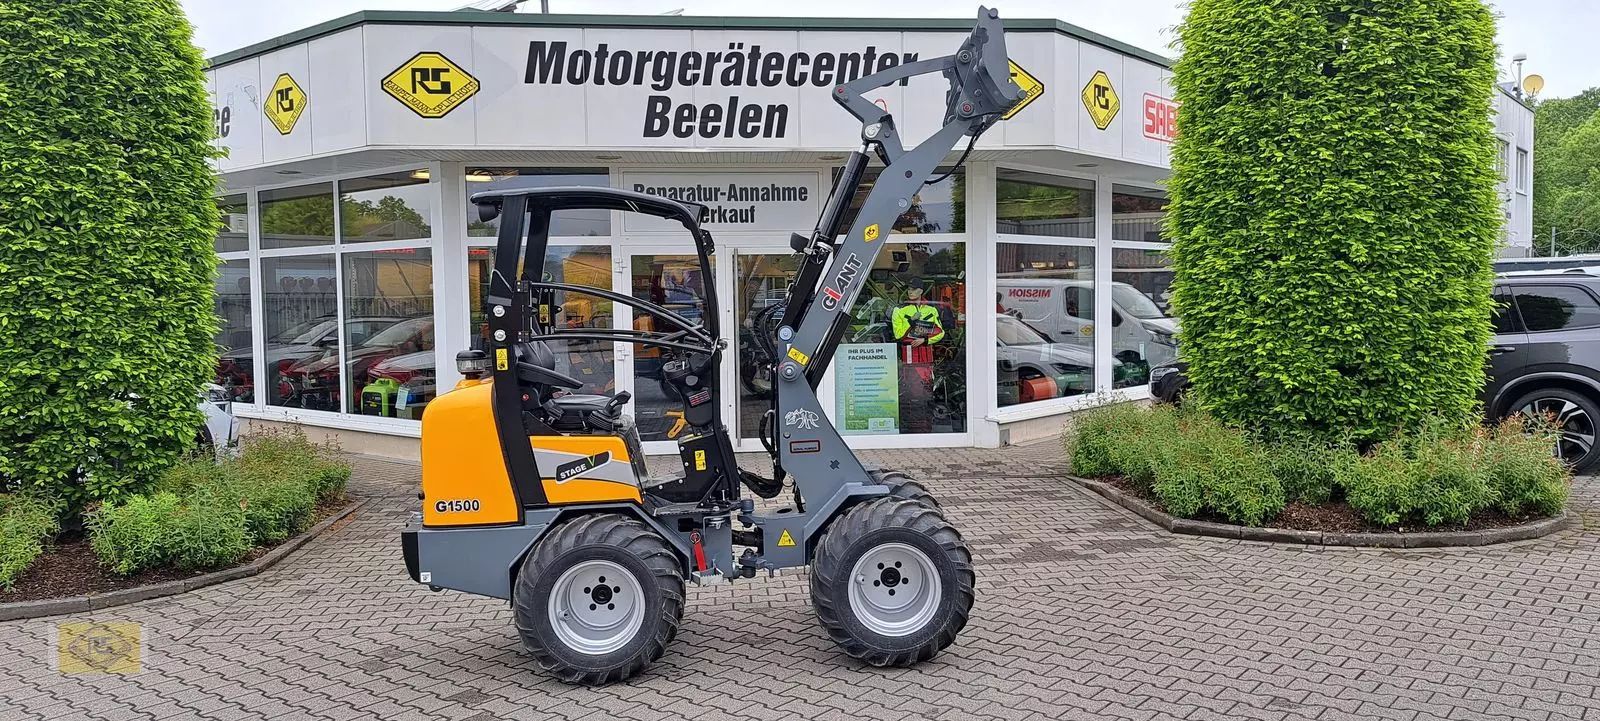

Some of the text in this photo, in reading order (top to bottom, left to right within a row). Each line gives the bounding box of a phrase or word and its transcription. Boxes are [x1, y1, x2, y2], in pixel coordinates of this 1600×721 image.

[524, 41, 919, 91] Motorgerätecenter
[643, 95, 789, 138] Beelen
[1145, 99, 1178, 138] SAB
[700, 206, 755, 224] erkauf
[560, 463, 587, 479] STAGE
[435, 499, 480, 513] G1500
